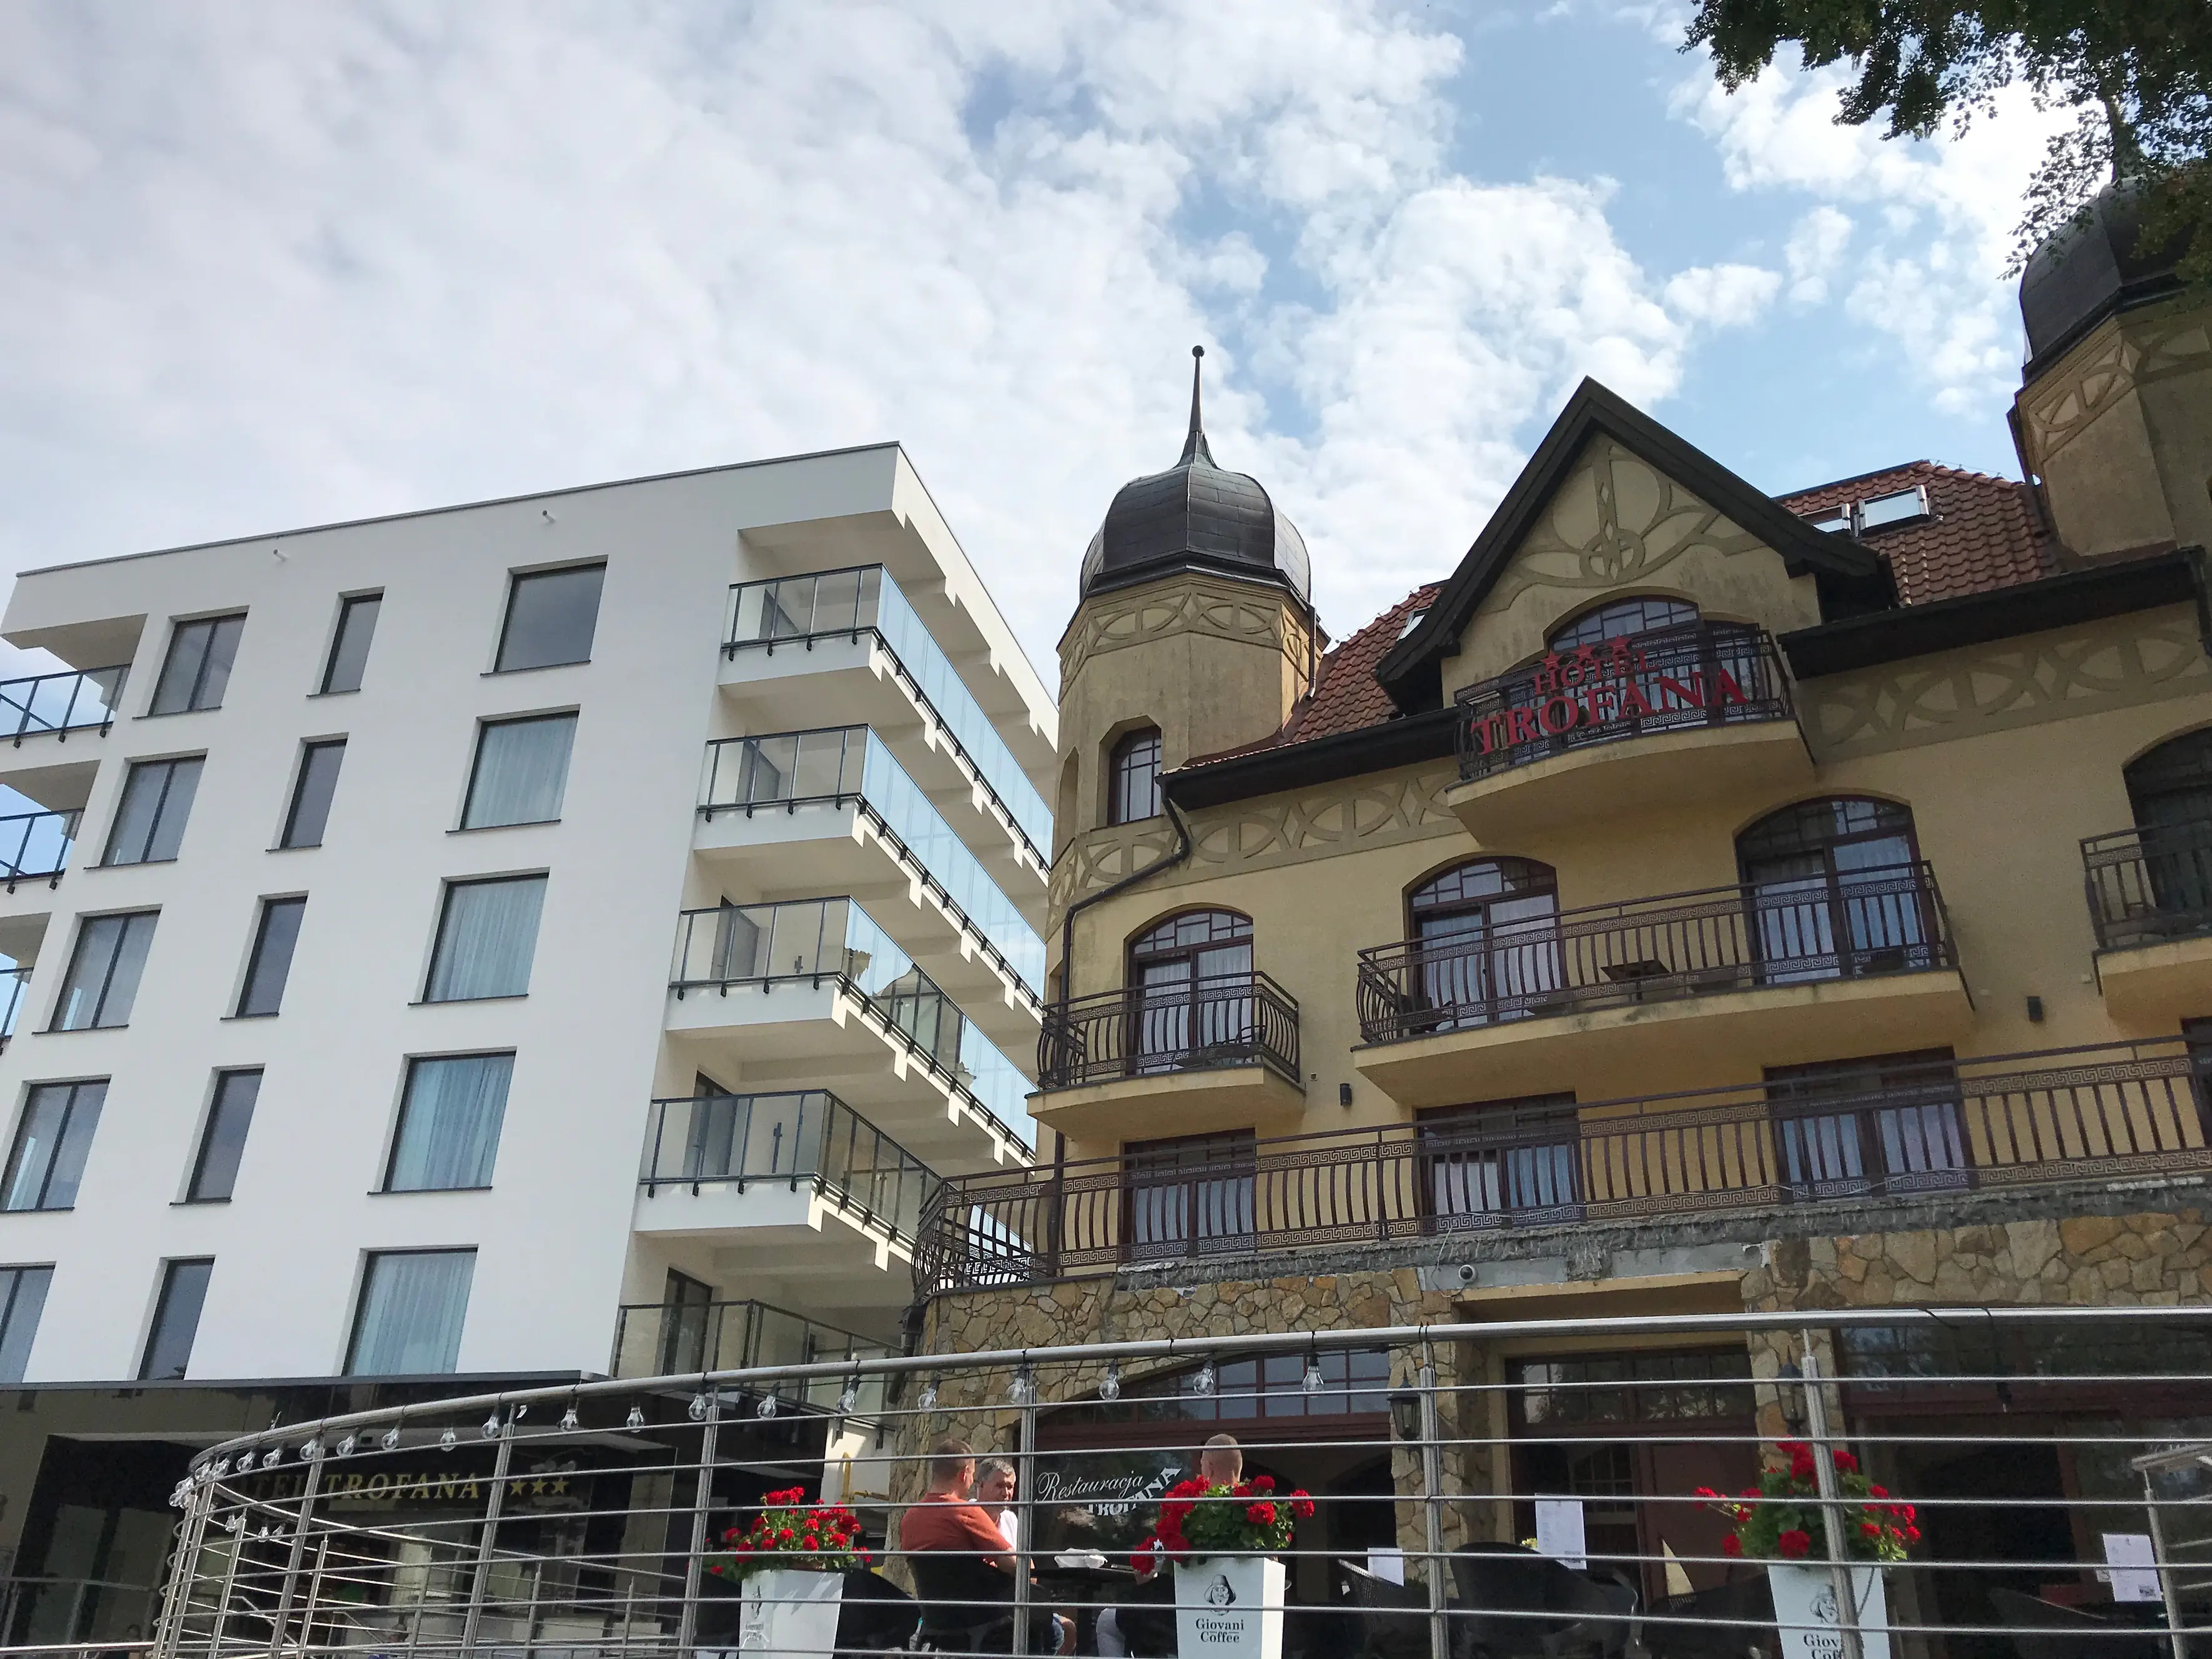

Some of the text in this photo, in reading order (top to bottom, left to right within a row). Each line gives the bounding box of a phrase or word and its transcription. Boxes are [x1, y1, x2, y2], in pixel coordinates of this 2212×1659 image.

[1534, 650, 1659, 695] HOTEL
[1471, 668, 1748, 755] TROFANA
[325, 1472, 479, 1501] TROFANA
[1034, 1470, 1144, 1502] Restauracja
[1195, 1618, 1245, 1630] Giovani
[1200, 1631, 1240, 1643] Coffee
[1803, 1633, 1840, 1647] Giov
